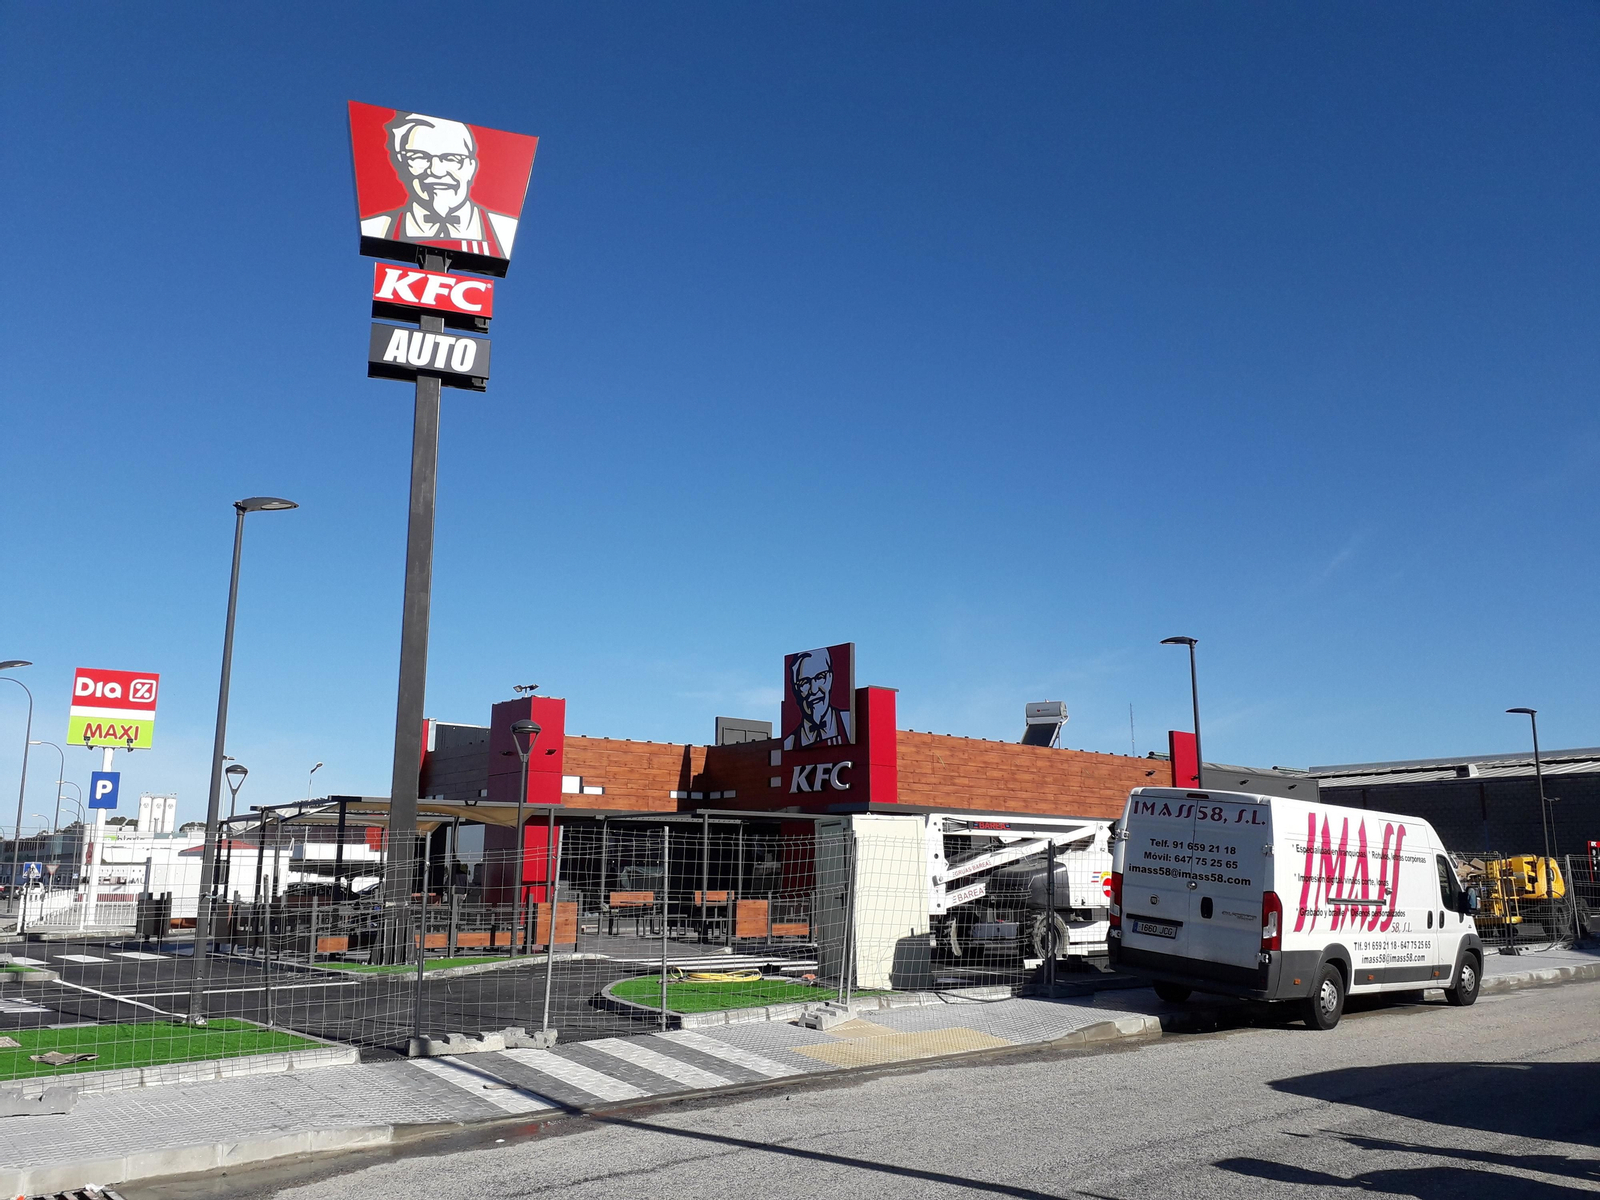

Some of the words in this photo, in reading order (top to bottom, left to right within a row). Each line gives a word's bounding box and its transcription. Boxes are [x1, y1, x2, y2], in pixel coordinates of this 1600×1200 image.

[375, 268, 487, 312] KFC
[383, 328, 477, 373] AUTO
[83, 722, 140, 741] MAXI
[789, 761, 853, 794] KFC
[95, 779, 113, 800] P
[979, 821, 1007, 830] BAREA
[1234, 808, 1266, 826] S.L.
[1150, 838, 1170, 848] Telf.
[1172, 840, 1184, 850] 91
[1187, 842, 1206, 852] 659
[1209, 844, 1220, 854] 21
[1224, 845, 1236, 855] 18
[954, 865, 972, 877] GRUAS
[972, 862, 990, 871] BAREA
[1143, 851, 1172, 862] Móvil:
[1174, 855, 1192, 864] 647
[1195, 857, 1207, 866] 75
[1210, 858, 1222, 868] 25
[1225, 860, 1238, 870] 65
[1128, 863, 1251, 887] imass58@imass58.com
[1293, 811, 1407, 936] IMASS
[957, 887, 985, 902] BAREA
[1299, 908, 1323, 917] Grabado
[1323, 910, 1328, 918] y
[1140, 922, 1157, 933] 1660
[1159, 925, 1173, 936] JCG
[1353, 942, 1363, 951] Tlf.
[1364, 941, 1371, 950] 91
[1371, 941, 1383, 950] 659
[1383, 941, 1390, 950] 21
[1391, 941, 1397, 950] 18
[1400, 940, 1410, 949] 647
[1411, 940, 1417, 949] 75
[1418, 940, 1424, 949] 25
[1425, 940, 1431, 949] 65
[1361, 952, 1426, 964] imass58@imass58.com
